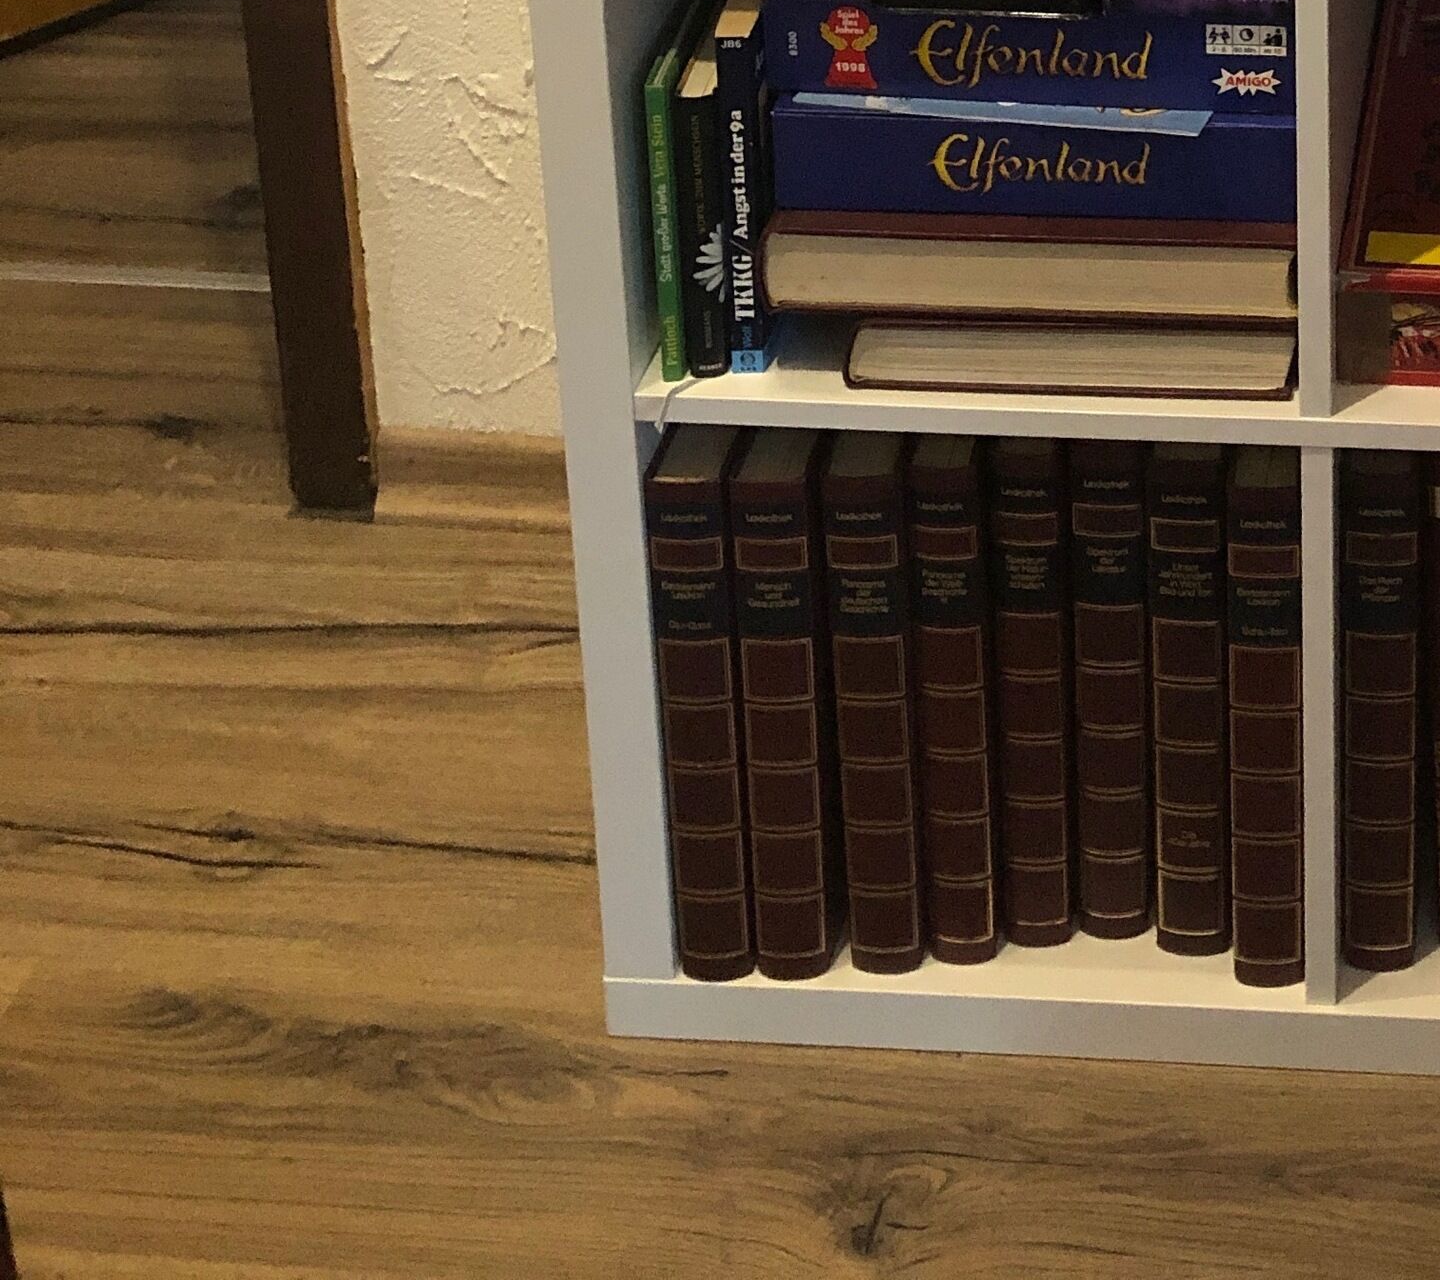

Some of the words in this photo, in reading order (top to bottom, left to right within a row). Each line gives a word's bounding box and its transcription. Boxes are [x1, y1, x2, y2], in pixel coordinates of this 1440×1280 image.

[909, 18, 1154, 90] Elfenland
[1225, 75, 1272, 88] AMIGO
[650, 114, 663, 147] Stein
[729, 110, 746, 133] 9a
[729, 135, 746, 163] der
[926, 132, 1151, 196] Elfenland
[731, 165, 747, 184] in
[732, 186, 751, 241] Angst
[658, 253, 673, 283] Statt
[731, 254, 755, 322] TKKG
[663, 315, 679, 366] Pattloch
